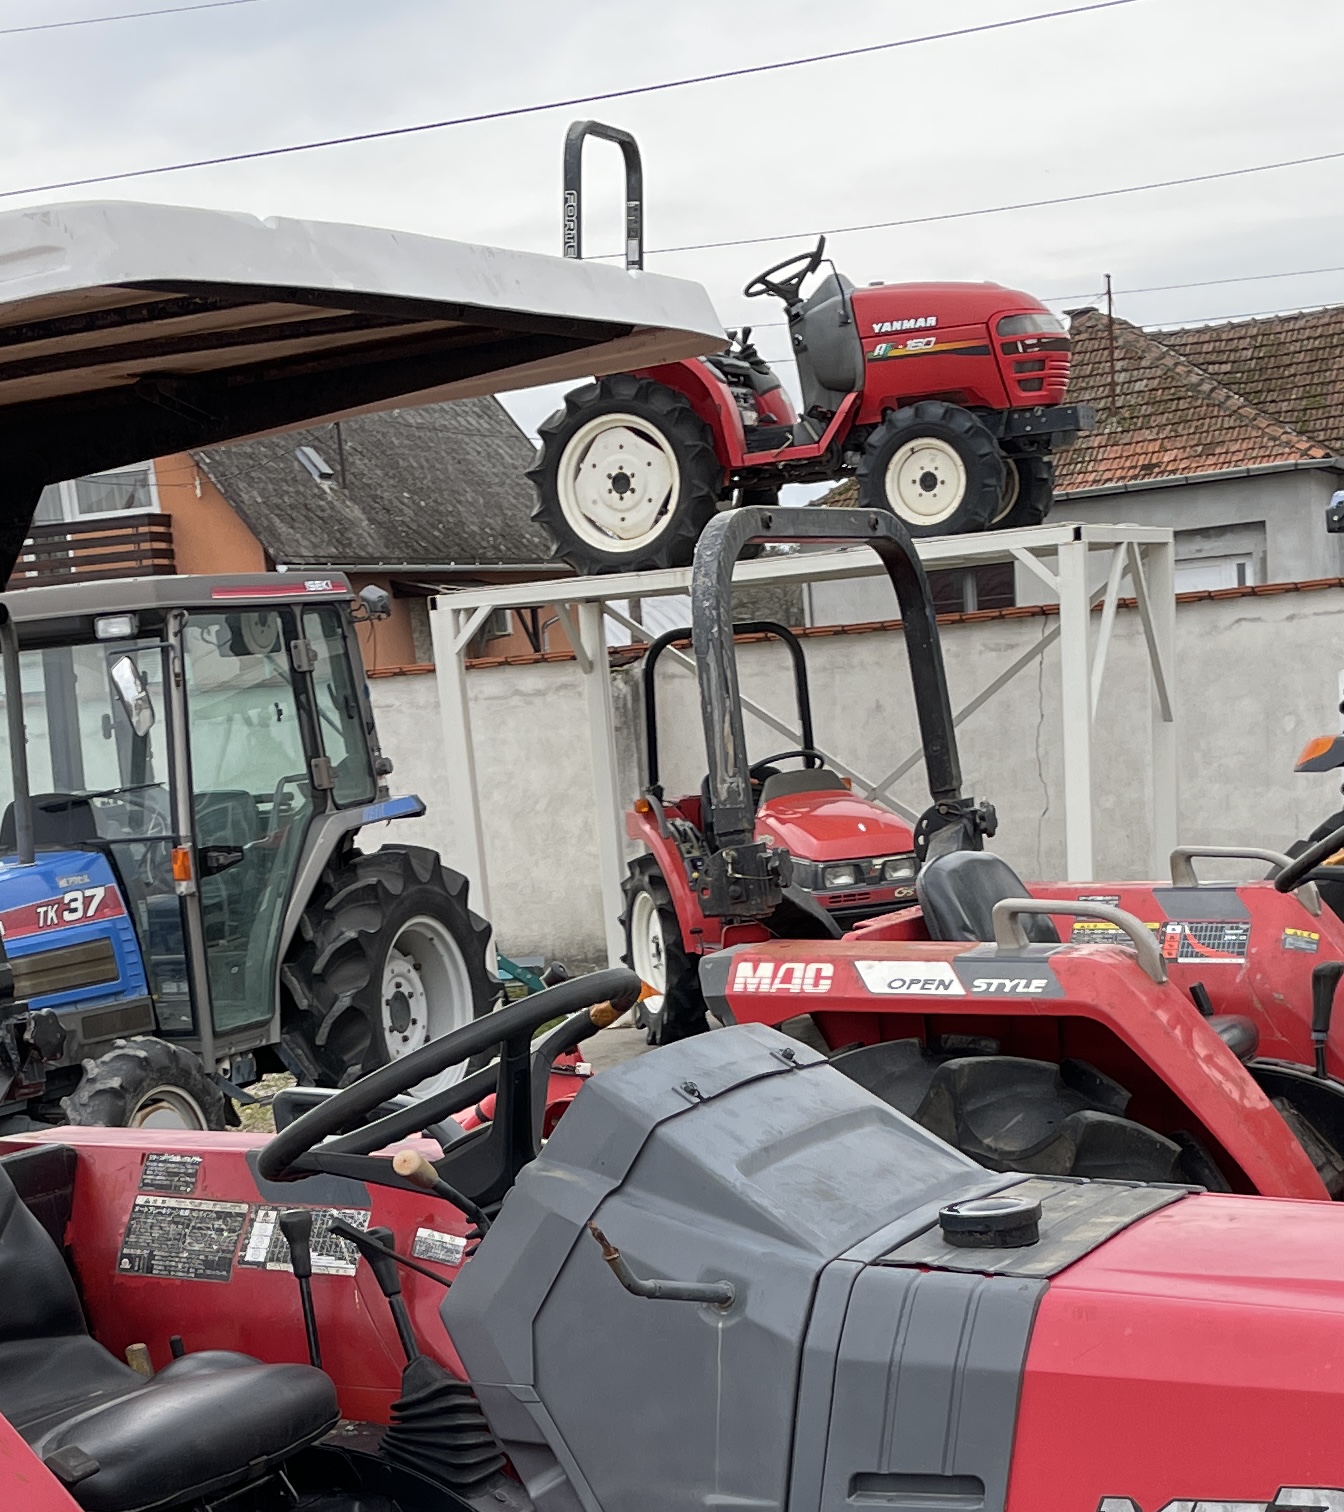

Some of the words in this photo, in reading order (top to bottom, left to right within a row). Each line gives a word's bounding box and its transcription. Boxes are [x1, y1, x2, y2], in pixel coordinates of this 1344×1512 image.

[872, 316, 937, 333] YANMAR
[733, 961, 834, 993] MAC
[887, 978, 954, 992] OPEN
[972, 979, 1048, 993] STYLE
